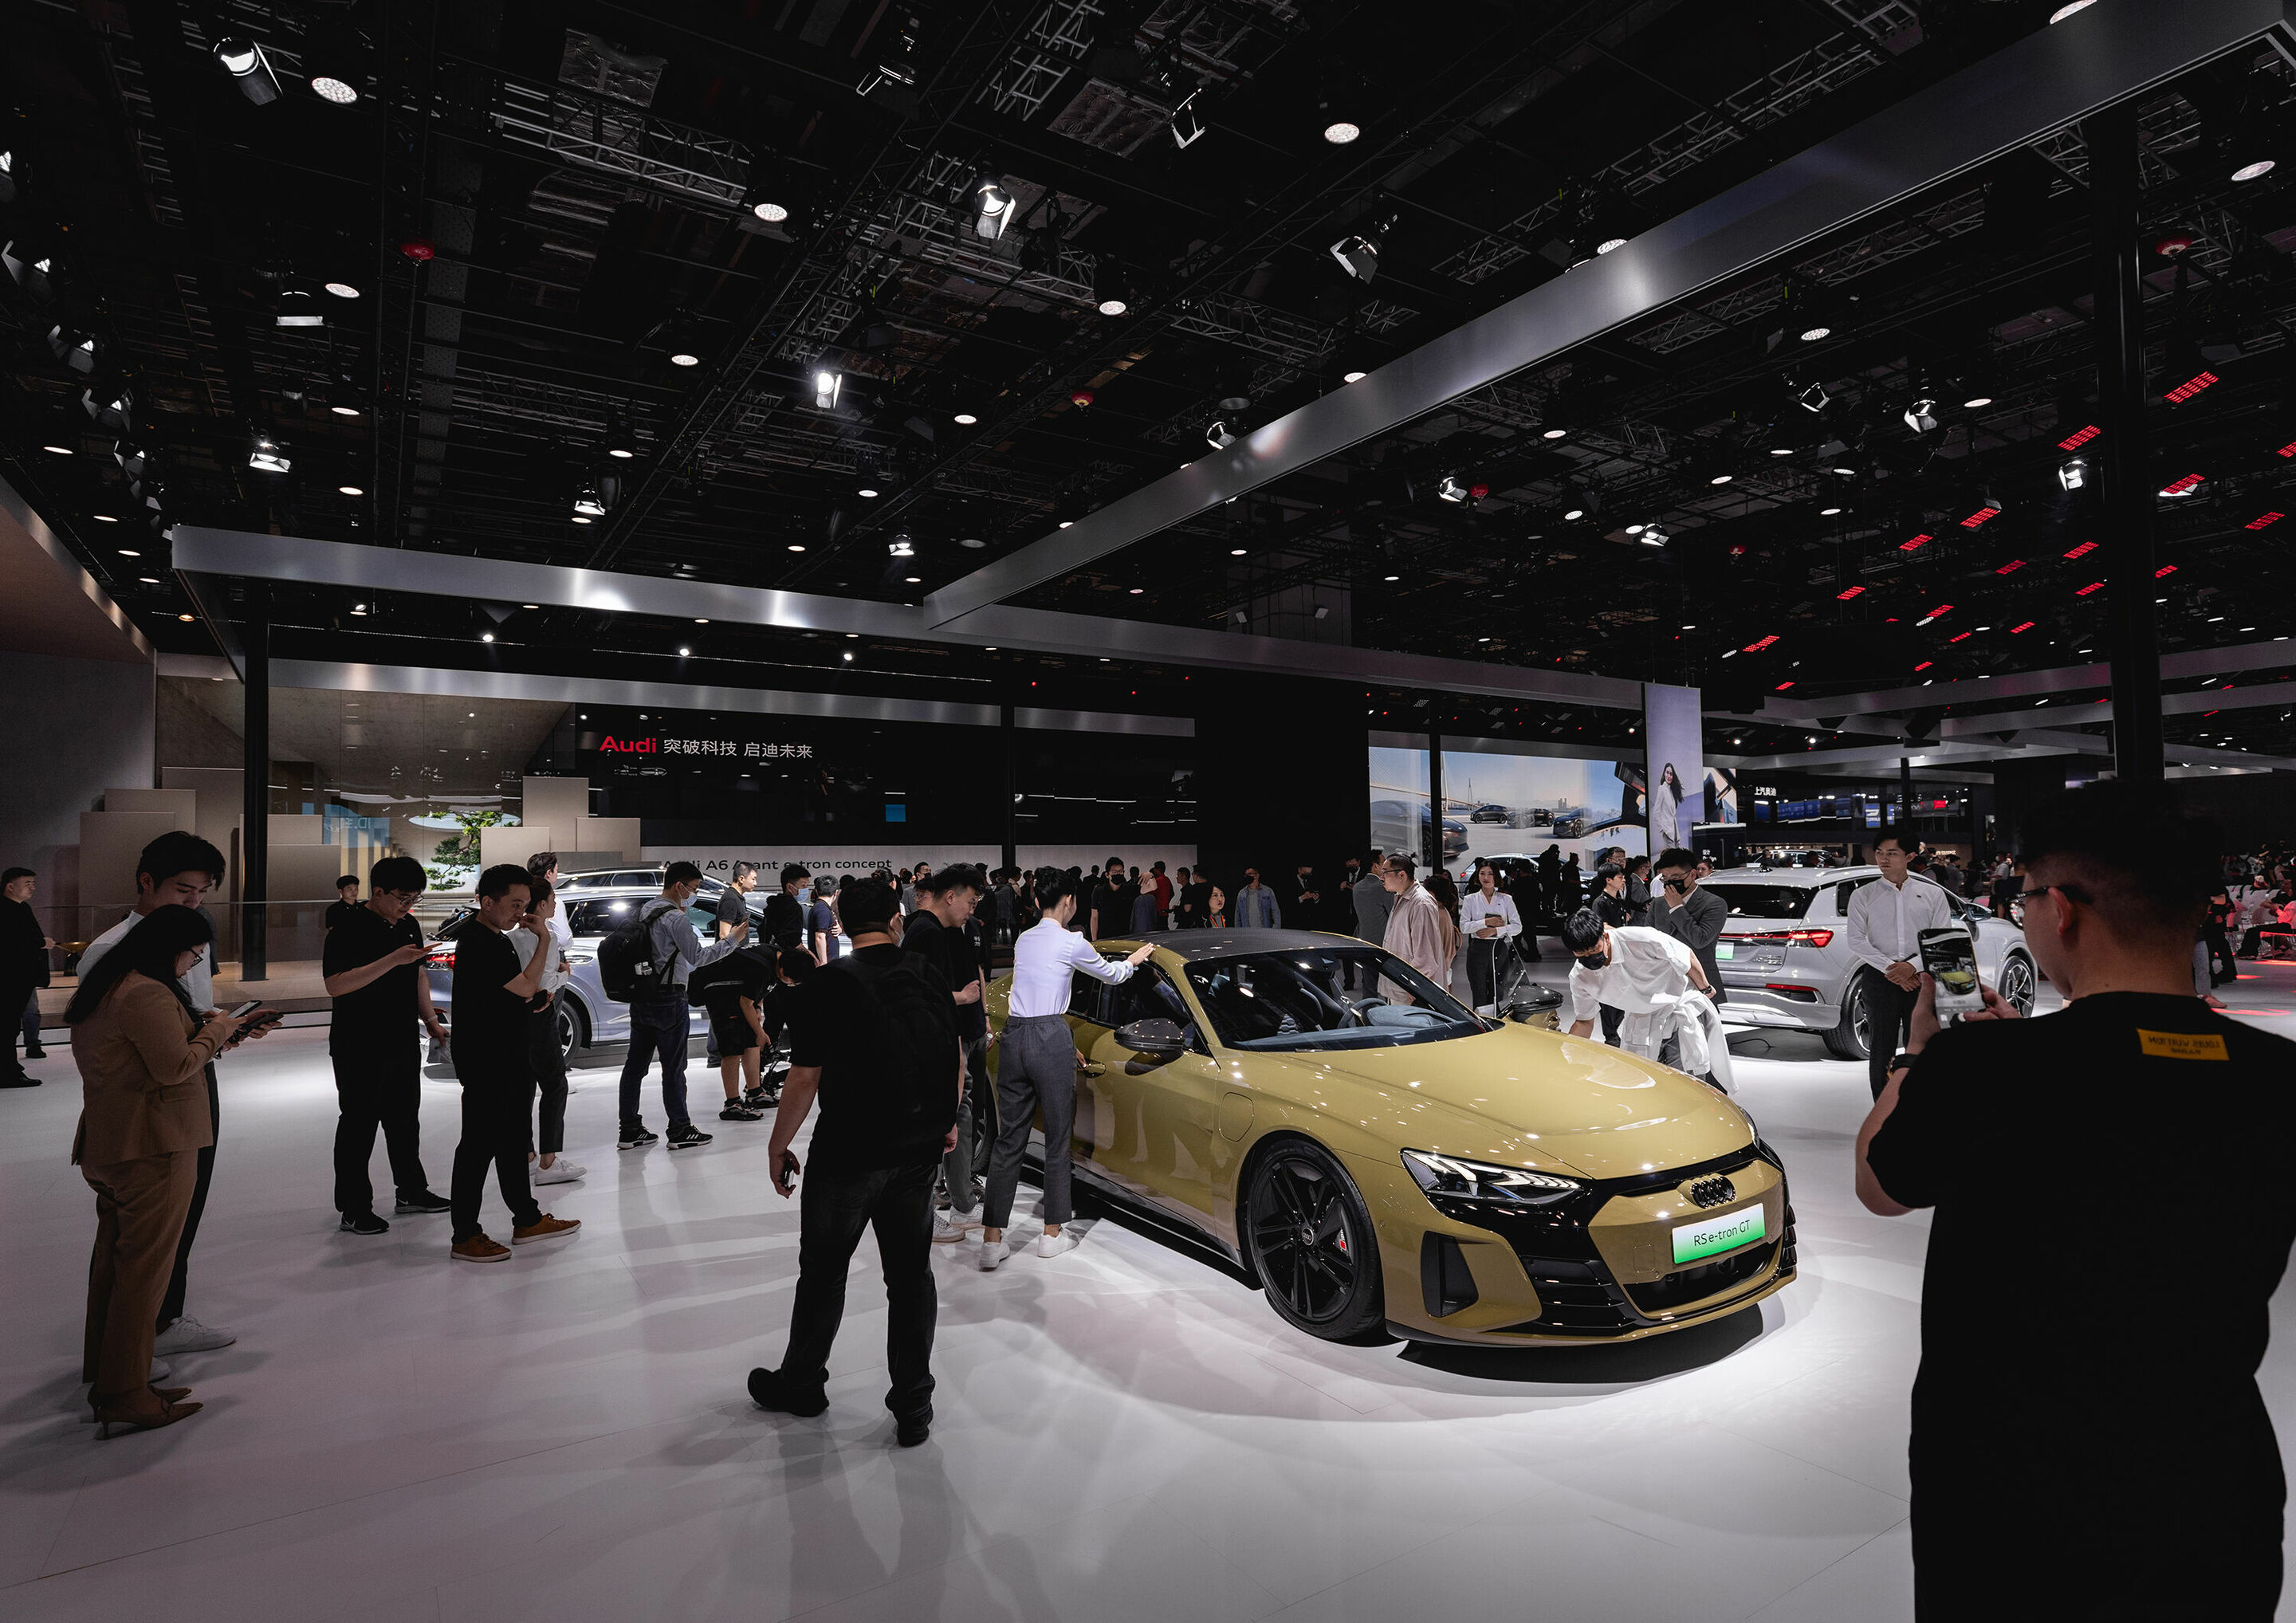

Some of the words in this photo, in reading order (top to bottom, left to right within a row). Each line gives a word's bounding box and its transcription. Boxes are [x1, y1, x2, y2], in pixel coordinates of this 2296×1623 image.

[600, 736, 657, 753] Audi
[663, 738, 737, 756] 突破科技
[744, 742, 812, 759] 启迪未来
[706, 859, 729, 870] A6
[835, 859, 892, 869] concept
[1693, 1232, 1708, 1247] RS
[1708, 1227, 1738, 1243] e-tron
[1739, 1220, 1751, 1232] GT
